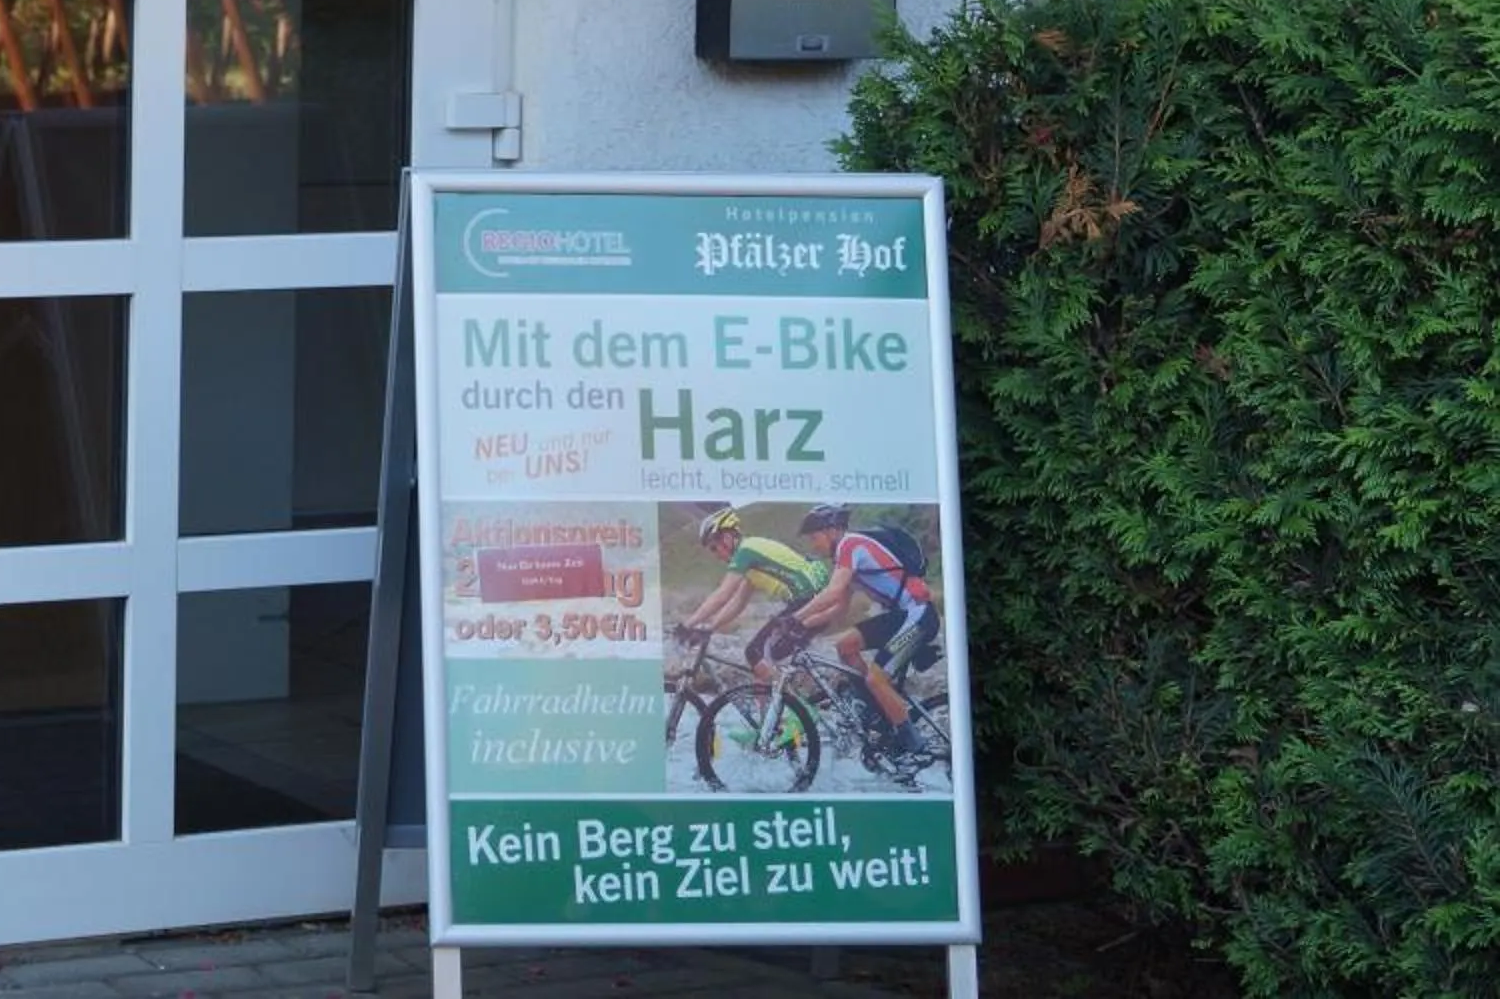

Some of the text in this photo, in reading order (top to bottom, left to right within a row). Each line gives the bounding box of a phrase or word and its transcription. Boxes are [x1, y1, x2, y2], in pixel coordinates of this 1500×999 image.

[724, 206, 875, 225] Hotelpension
[694, 232, 908, 278] Pfälzer Hof
[463, 315, 909, 372] Mit dem E-Bike
[461, 379, 826, 462] durch den Harz
[474, 432, 529, 461] NEU
[640, 467, 911, 495] leicht, bequem, schnell
[455, 613, 527, 640] oder
[448, 683, 657, 715] Fahrradhelm
[470, 728, 638, 764] inclusive
[467, 806, 850, 865] Kein Berg zu steil,
[574, 845, 930, 904] kein Ziel zu weit!
